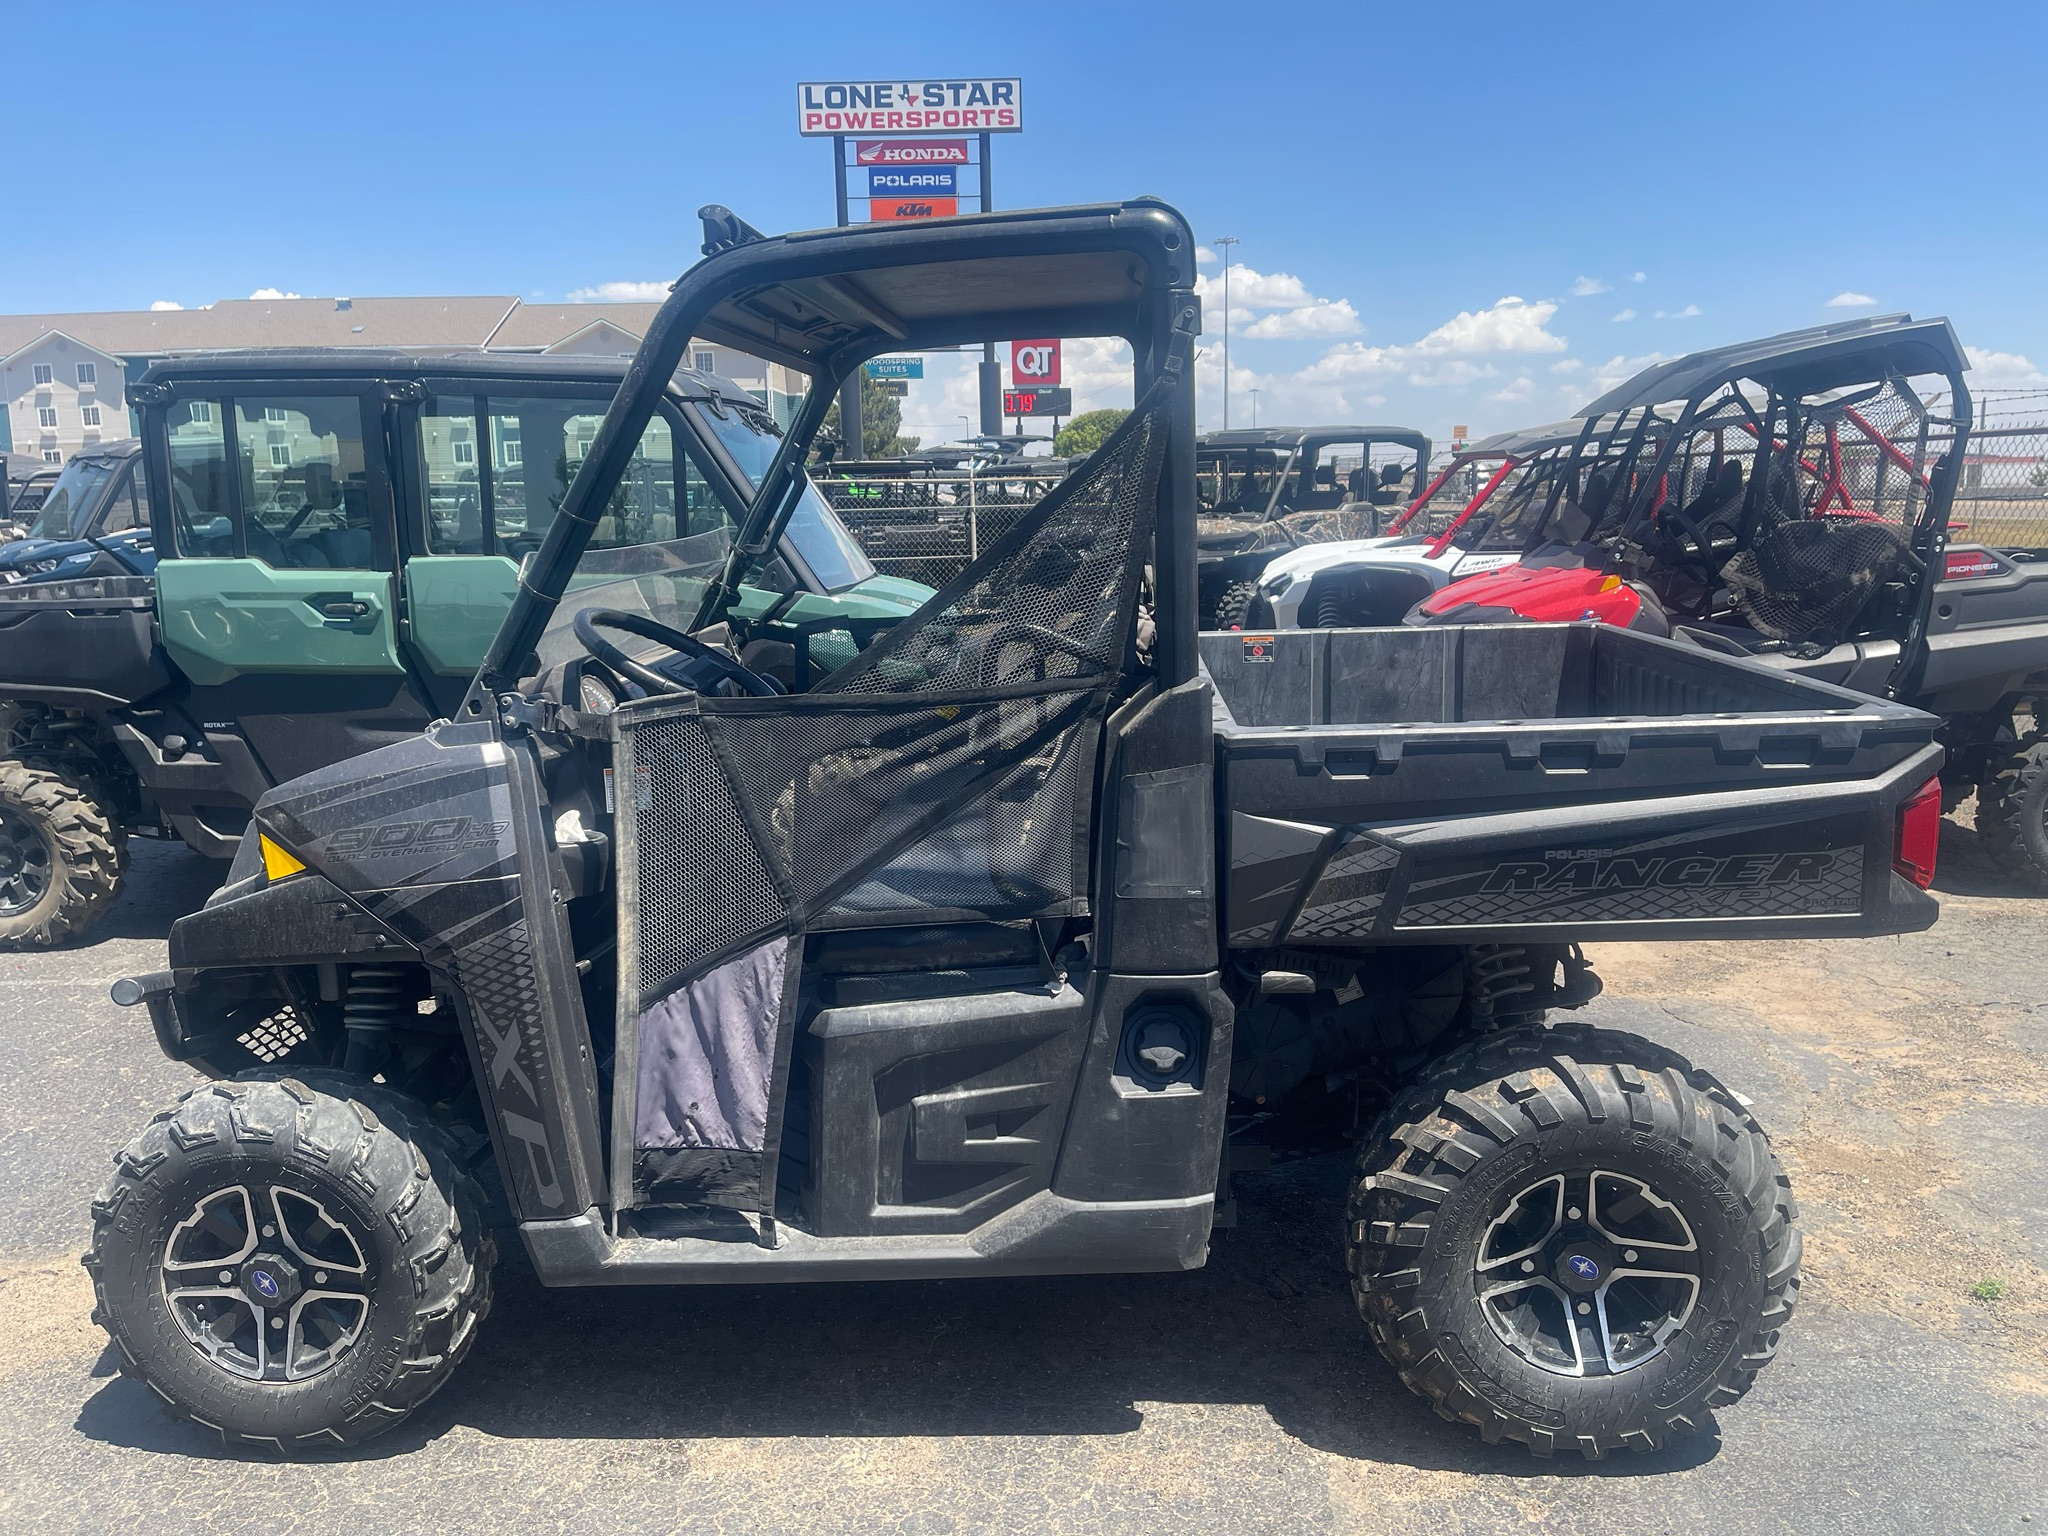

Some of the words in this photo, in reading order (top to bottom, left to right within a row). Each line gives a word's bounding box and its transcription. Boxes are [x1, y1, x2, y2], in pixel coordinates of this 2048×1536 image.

[804, 84, 893, 109] LONE
[922, 82, 1014, 107] STAR
[806, 108, 1015, 130] POWERSPORTS
[883, 147, 965, 161] HONDA
[873, 174, 952, 187] POLARIS
[895, 202, 932, 217] KTM
[864, 358, 921, 366] WOODSPRING
[878, 365, 908, 373] SUITES
[1016, 346, 1054, 376] QT
[1947, 563, 1998, 573] PIONEER
[325, 816, 473, 855] 900
[326, 852, 366, 864] DUAL
[370, 843, 457, 859] OVERHEAD
[462, 839, 500, 851] CAM
[1544, 848, 1614, 860] POLARIS
[1478, 852, 1837, 895] RANGER
[1631, 1131, 1744, 1221] CARLSTAR
